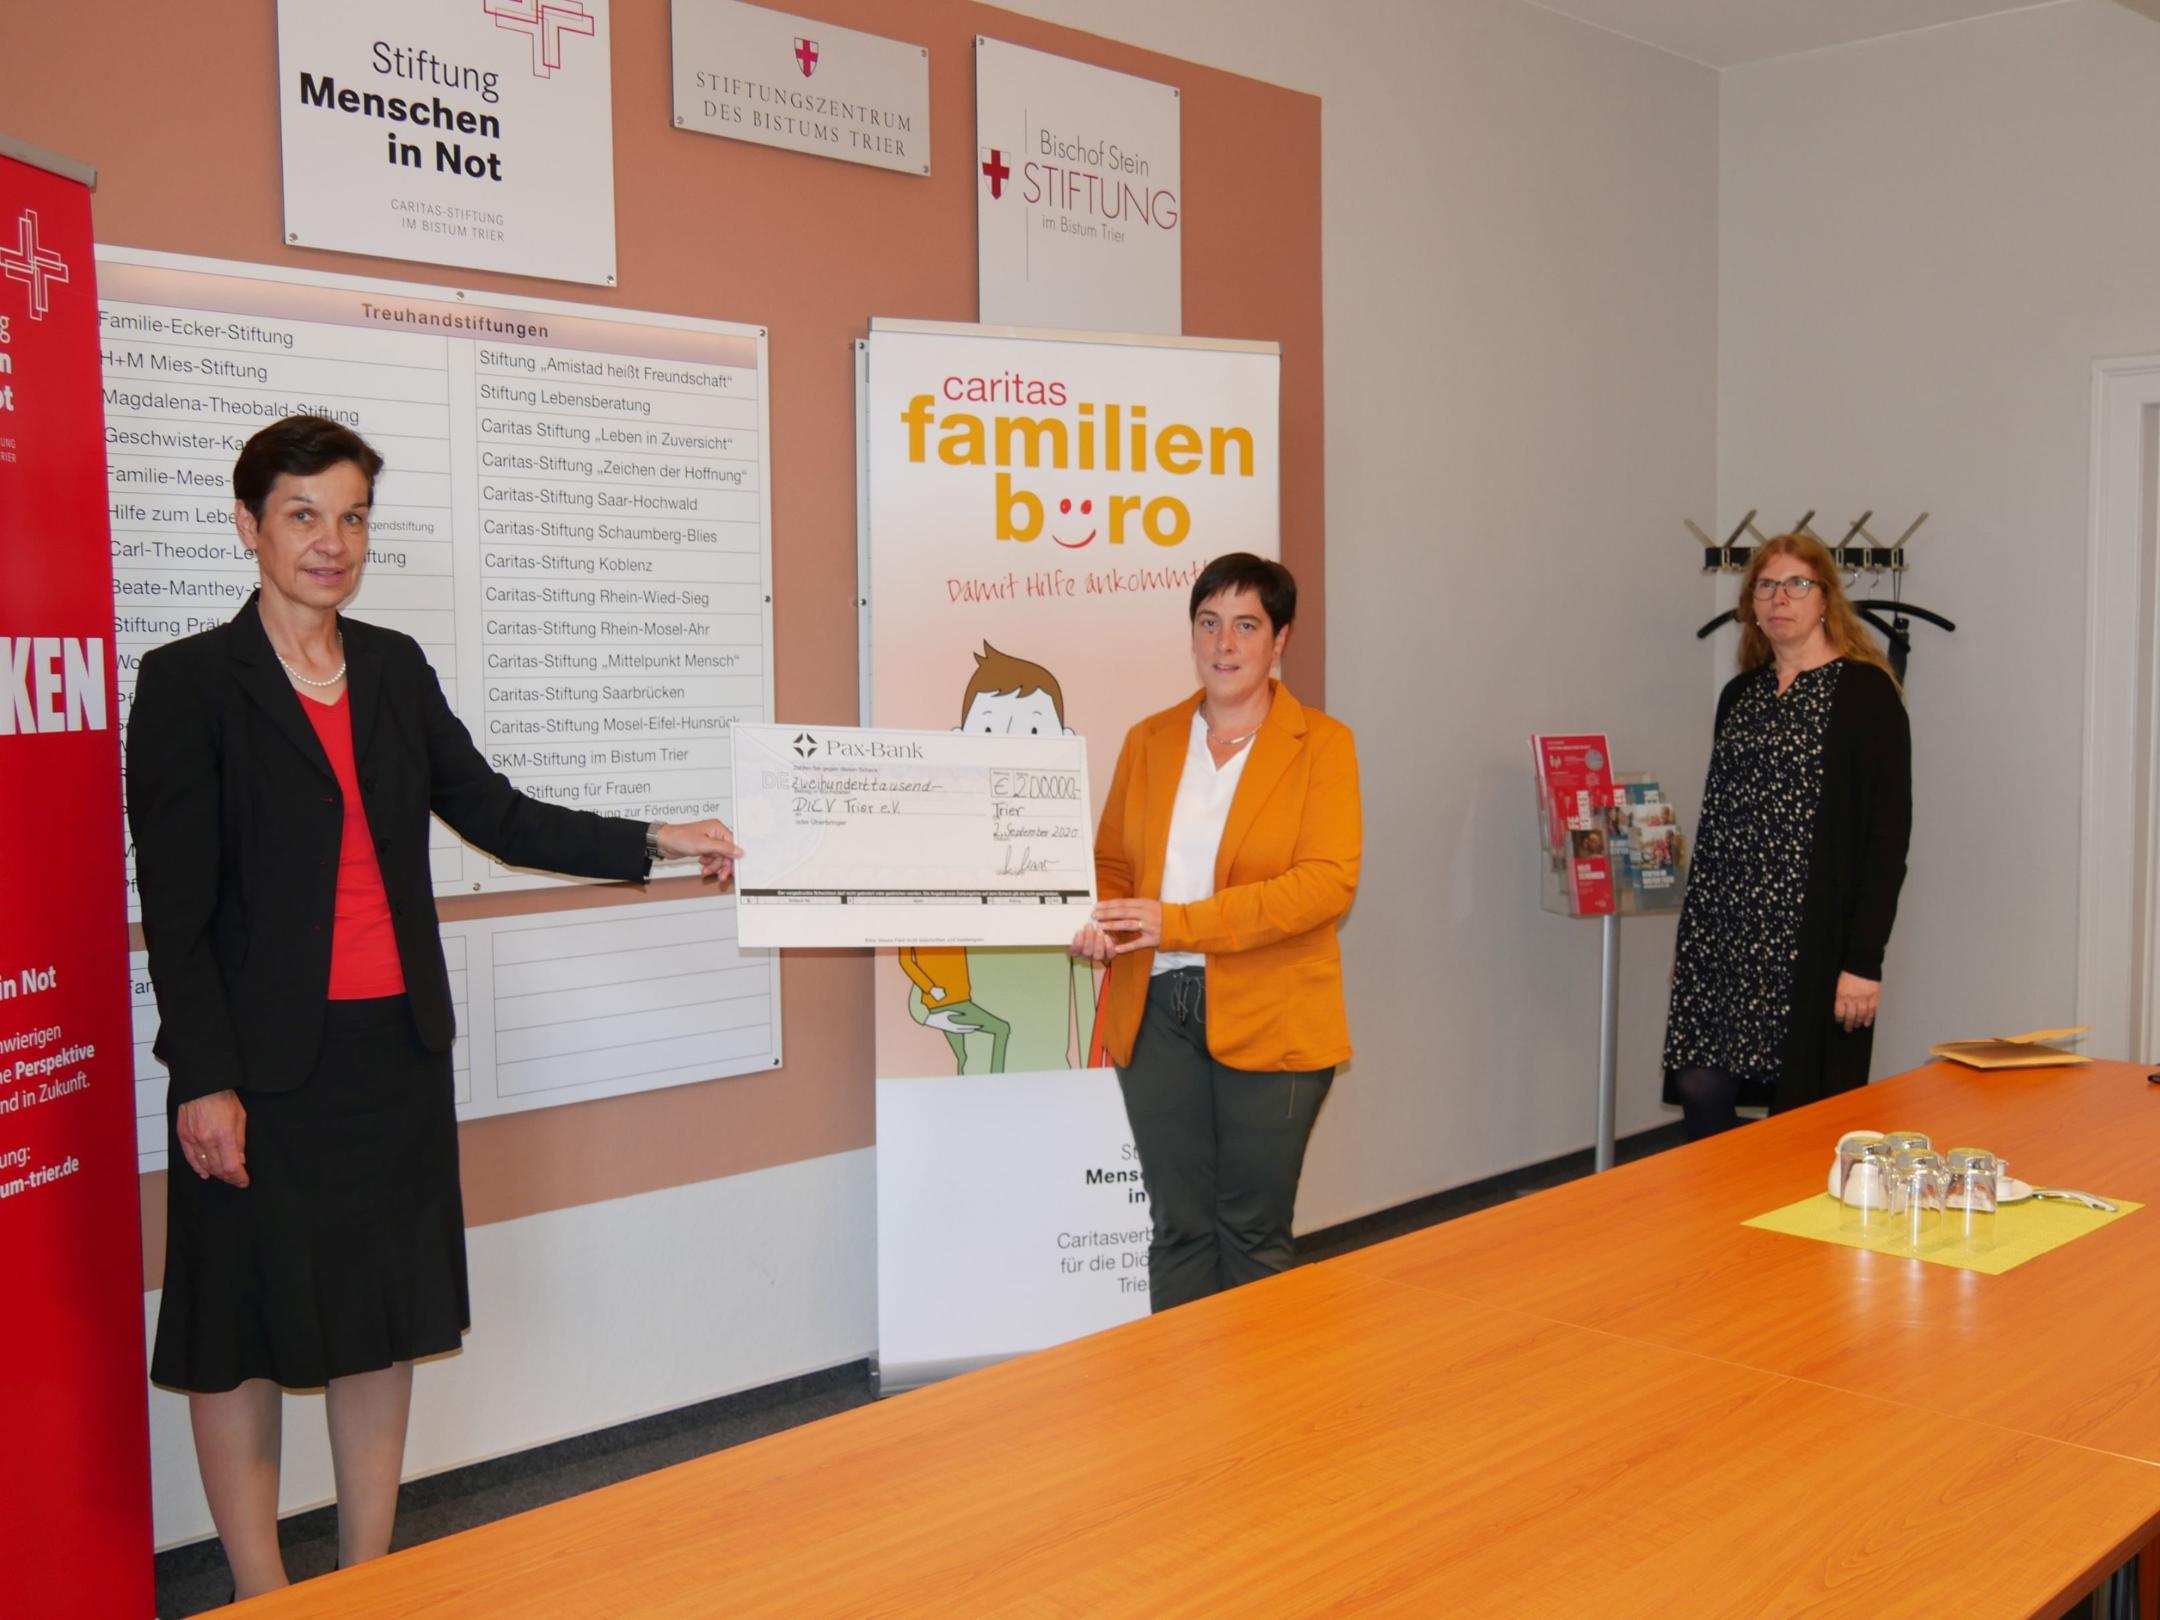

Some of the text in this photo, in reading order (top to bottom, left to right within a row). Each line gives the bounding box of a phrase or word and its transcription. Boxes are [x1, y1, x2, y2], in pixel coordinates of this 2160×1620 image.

[373, 41, 500, 103] Stiftung
[300, 71, 500, 138] Menschen
[696, 71, 911, 132] STIFTUNGSZENTRUM
[703, 100, 906, 157] DES BISTUMS TRIER
[387, 133, 502, 182] in Not
[1040, 129, 1150, 177] Bischof Stein
[1023, 162, 1178, 230] STIFTUNG
[390, 198, 505, 226] CARITAS-STIFTUNG
[401, 216, 505, 242] IM BISTUM TRIER
[1041, 215, 1126, 243] im Bistum Trier
[98, 311, 294, 348] Familie-Ecker-Stiftung
[361, 303, 549, 340] Treuhandstiftungen
[100, 351, 268, 383] H+M Mies-Stiftung
[480, 349, 733, 389] Stiftung „Amistad heißt Freundschaft“
[480, 384, 651, 415] Stiftung Lebensberatung
[943, 371, 1067, 406] caritas
[102, 389, 359, 426] Magdalena-Theobald-Stiftung
[104, 427, 245, 451] Geschwister-Ka
[481, 418, 733, 451] Caritas Stiftung „Leben in Zuversicht“
[900, 393, 1255, 477] familien
[482, 451, 593, 475] Caritas-Stiftung
[660, 465, 680, 480] der
[483, 486, 698, 511] Caritas-Stiftung Saar-Hochwald
[109, 504, 146, 521] Hilfe
[152, 509, 189, 522] zum
[484, 519, 718, 544] Caritas-Stiftung Schaumberg-Blies
[111, 539, 259, 563] Carl-Theodor-Le
[485, 553, 652, 573] Caritas-Stiftung Koblenz
[486, 587, 709, 608] Caritas-Stiftung Rhein-Wied-Sieg
[946, 573, 1018, 603] Damit
[1026, 569, 1075, 597] Hilfe
[114, 617, 179, 637] Stiftung
[486, 619, 710, 639] Caritas-Stiftung Rhein-Mosel-Ahr
[488, 653, 597, 672] Caritas-Stiftung
[489, 685, 685, 705] Caritas-Stiftung Saarbrücken
[490, 715, 740, 738] Caritas-Stiftung Mosel-Eifel-Hunsrück
[492, 748, 688, 771] SKM-Stiftung im Bistum Trier
[827, 740, 924, 759] Pax-Bank
[526, 779, 651, 802] Stiftung für Frauen
[624, 807, 641, 818] zur
[645, 803, 700, 819] Förderung
[703, 801, 719, 813] der
[844, 798, 874, 815] Trier
[992, 802, 1025, 820] Trier
[21, 965, 57, 995] Not
[15, 1043, 95, 1080] Perspektive
[23, 1090, 36, 1108] in
[39, 1071, 91, 1104] Zukunft.
[1086, 1169, 1144, 1185] Mens
[1128, 1188, 1146, 1203] in
[1061, 1257, 1084, 1274] für
[1089, 1255, 1115, 1271] die
[1117, 1277, 1150, 1293] Trie
